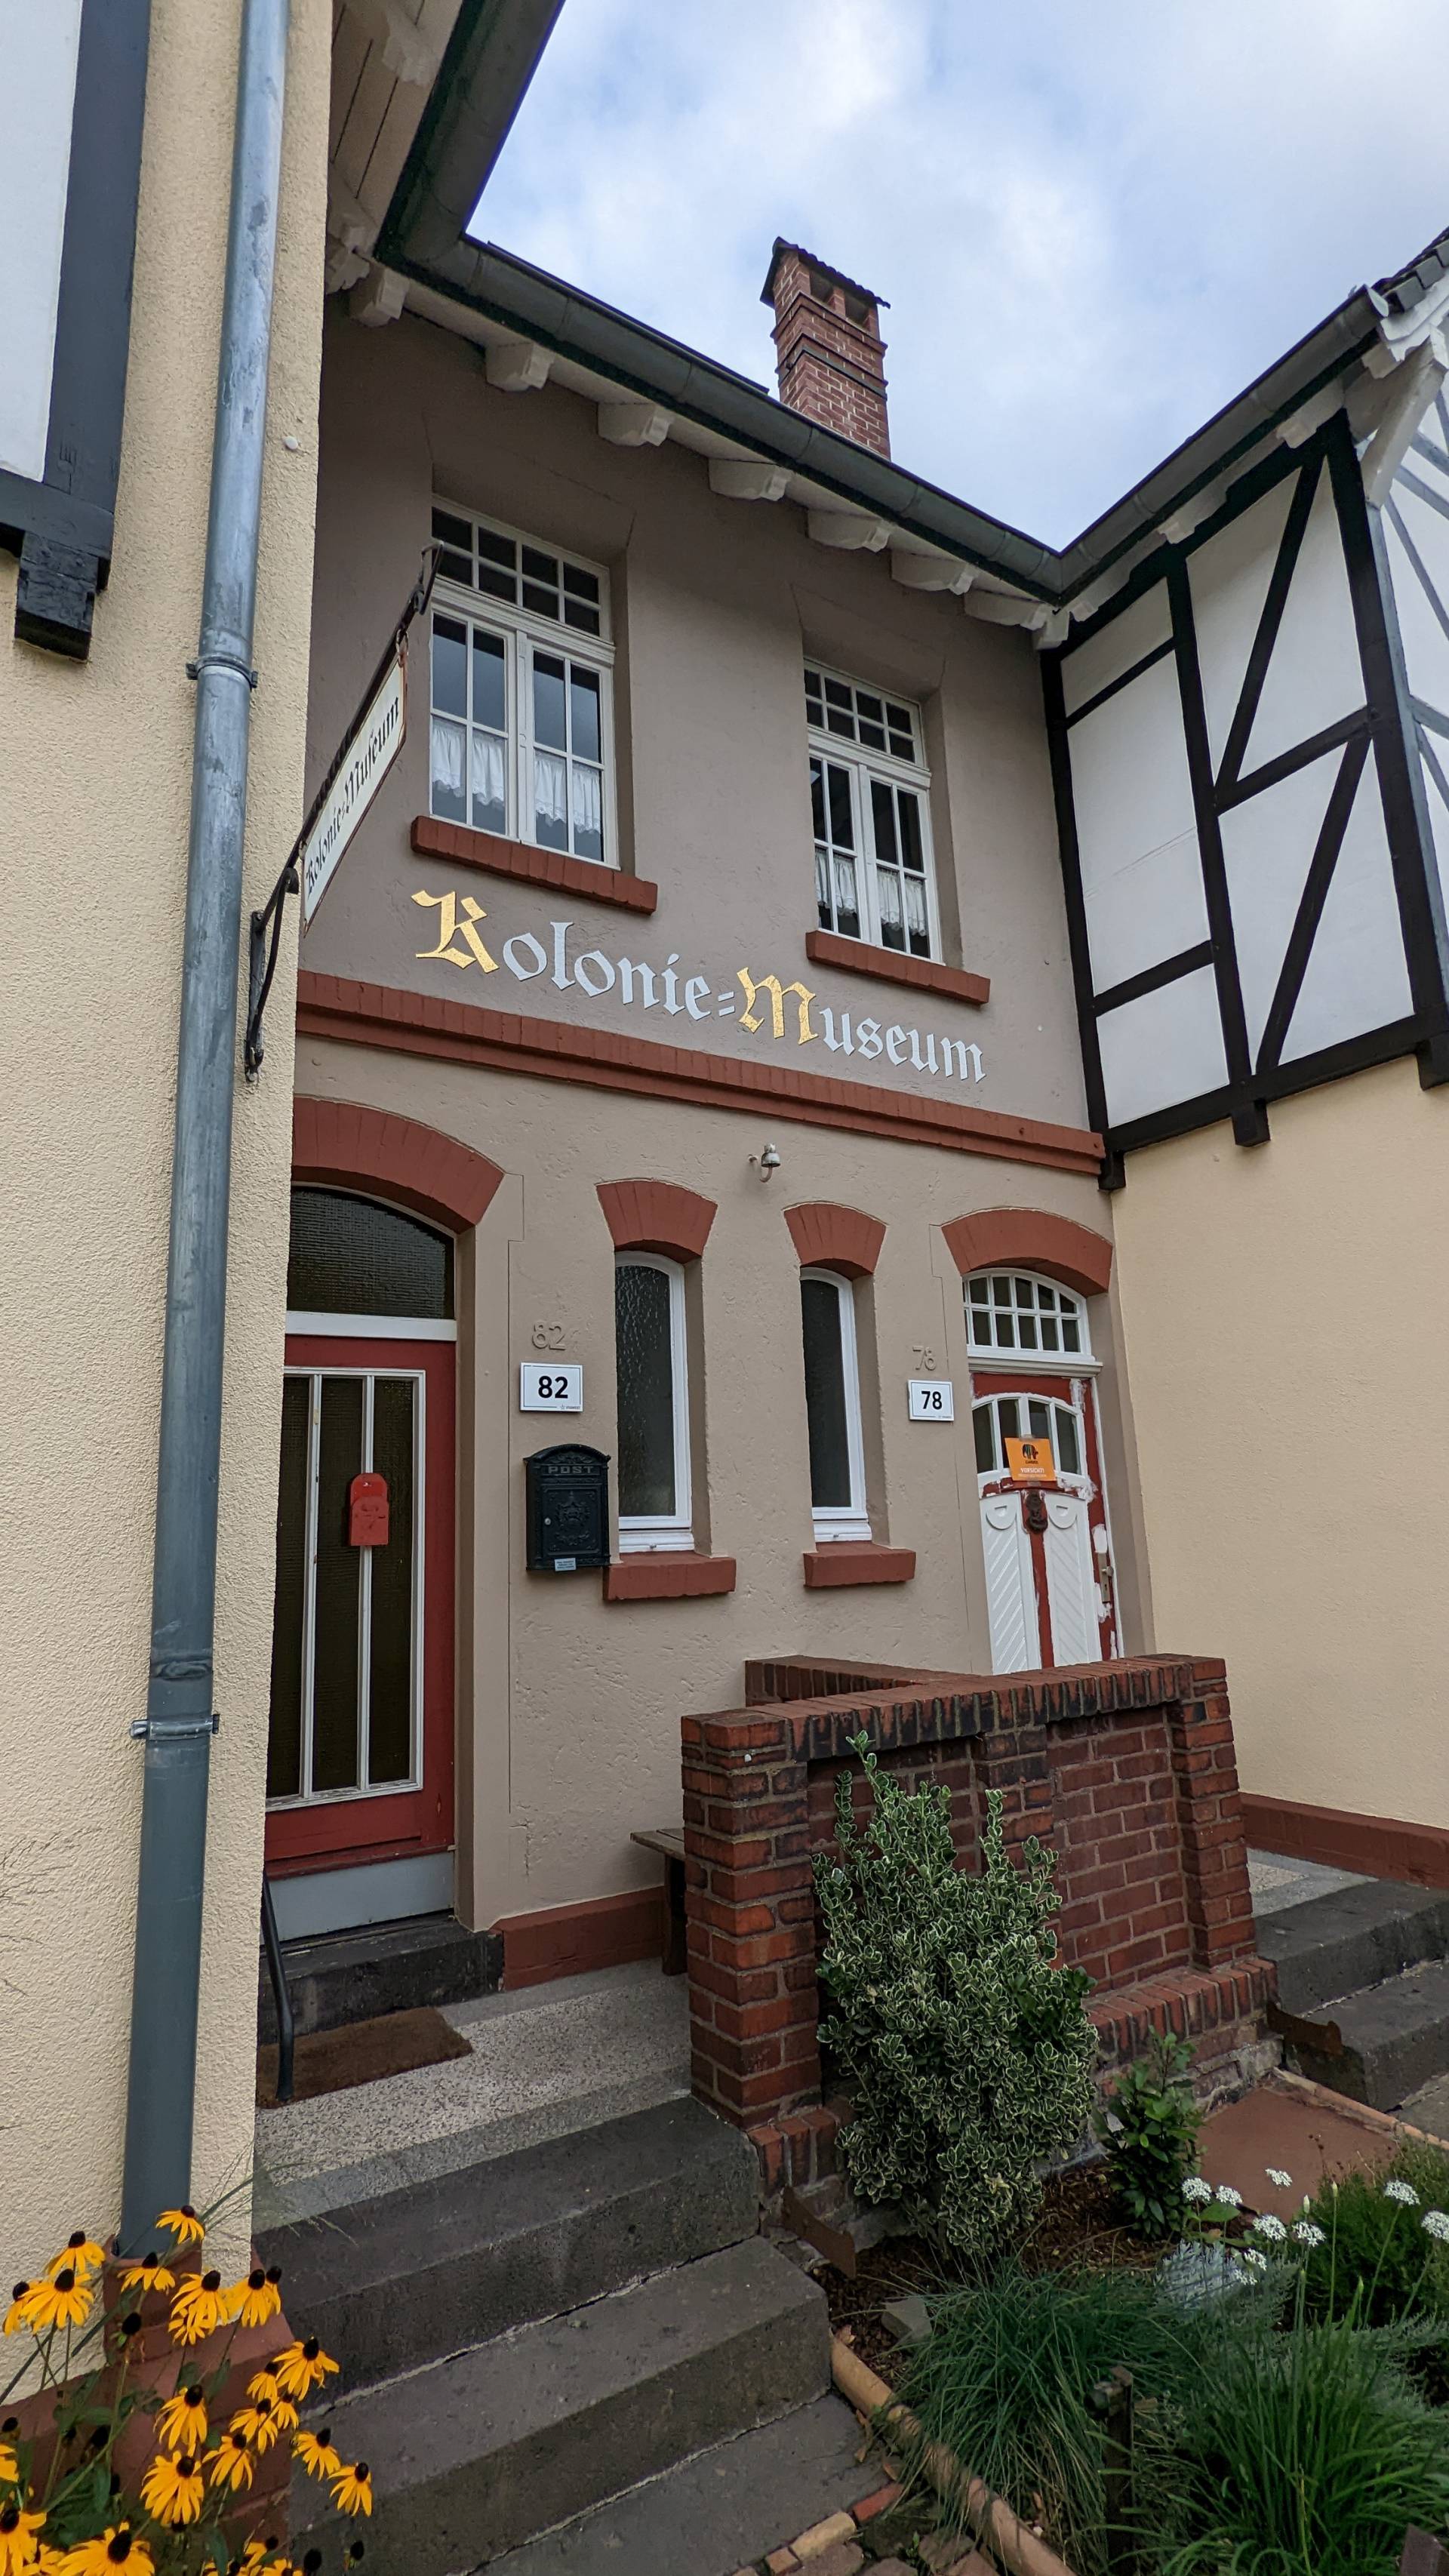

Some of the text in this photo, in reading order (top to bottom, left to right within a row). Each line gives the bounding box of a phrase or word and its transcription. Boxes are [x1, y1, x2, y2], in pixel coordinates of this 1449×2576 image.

[531, 1321, 566, 1351] 82
[538, 1375, 568, 1399] 82
[921, 1390, 943, 1410] 78
[548, 1466, 594, 1474] POST
